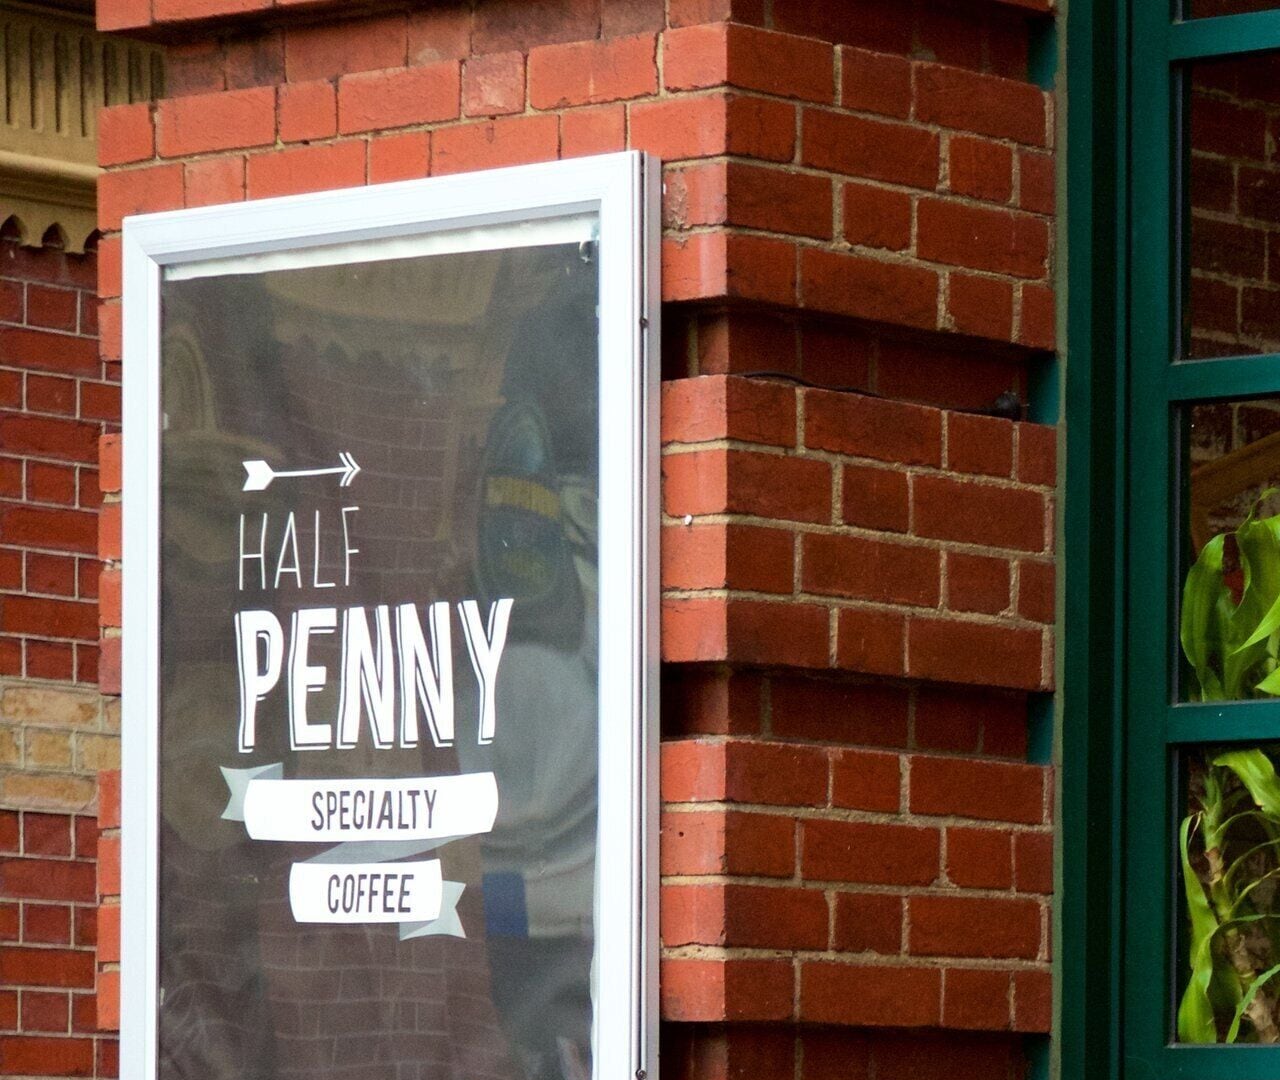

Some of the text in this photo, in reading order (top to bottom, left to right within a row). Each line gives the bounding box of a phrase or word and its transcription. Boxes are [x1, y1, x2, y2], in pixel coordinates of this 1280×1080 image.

[238, 506, 360, 590] HALF
[234, 598, 515, 753] PENNY
[311, 789, 438, 831] SPECIALTY
[327, 873, 415, 914] COFFEE
